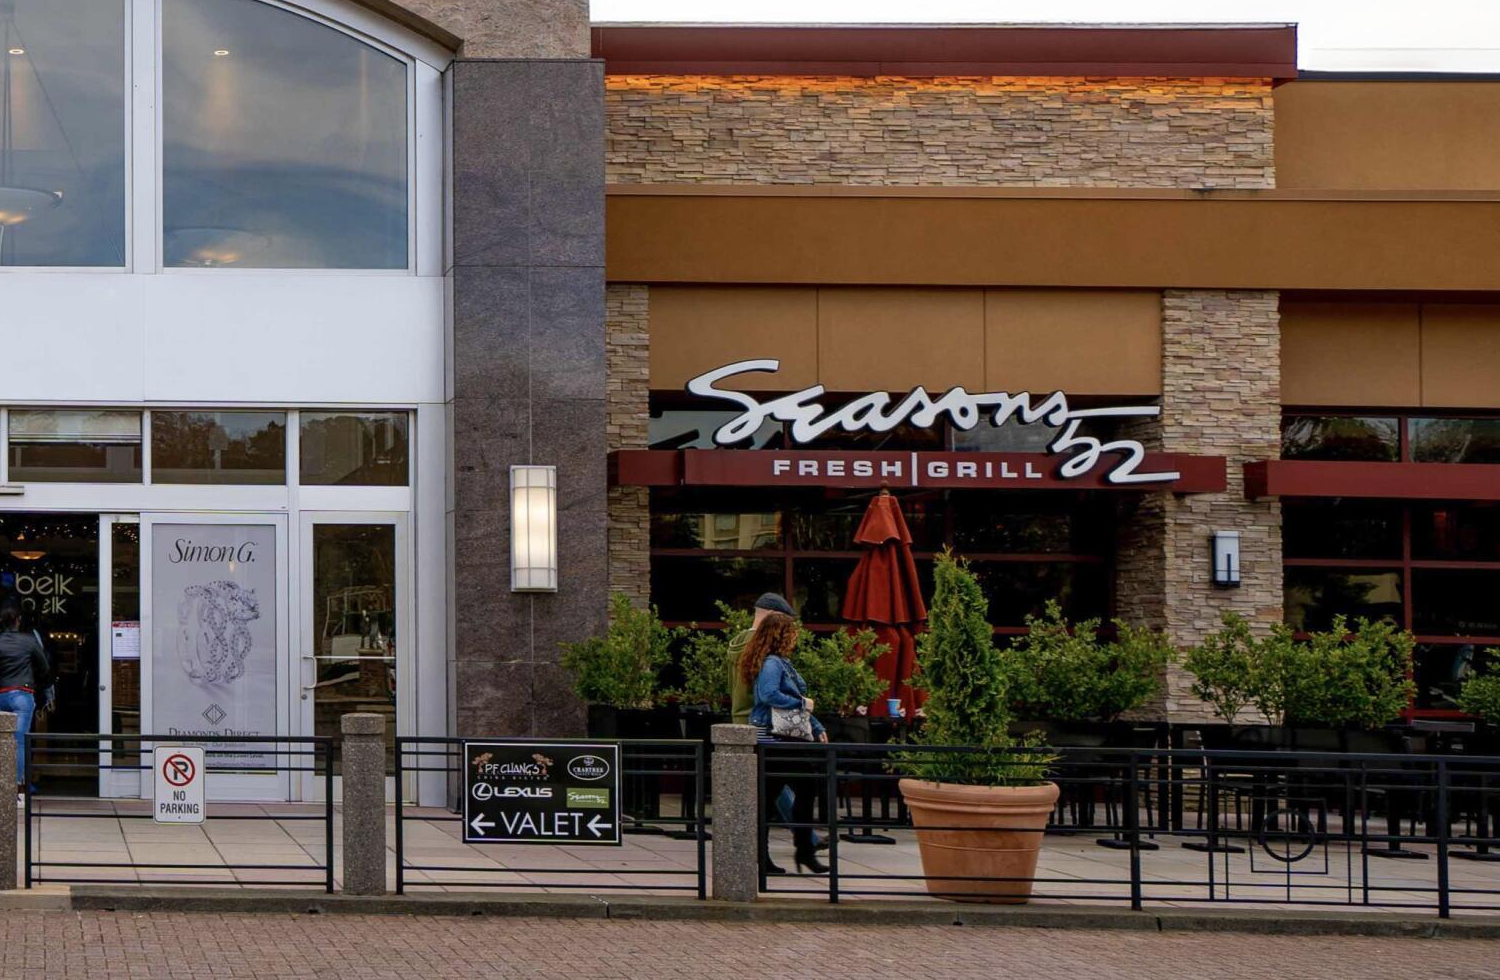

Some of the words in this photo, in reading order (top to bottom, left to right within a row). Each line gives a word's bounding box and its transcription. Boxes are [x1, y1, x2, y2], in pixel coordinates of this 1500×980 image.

[684, 358, 1078, 446] Seasons
[1048, 404, 1181, 483] 52
[773, 460, 902, 478] FRESH
[927, 461, 1043, 479] GRILL
[15, 573, 74, 596] belk
[173, 790, 186, 801] NO
[493, 787, 553, 798] LEXUS
[160, 803, 200, 814] PARKING
[500, 811, 584, 836] VALET
